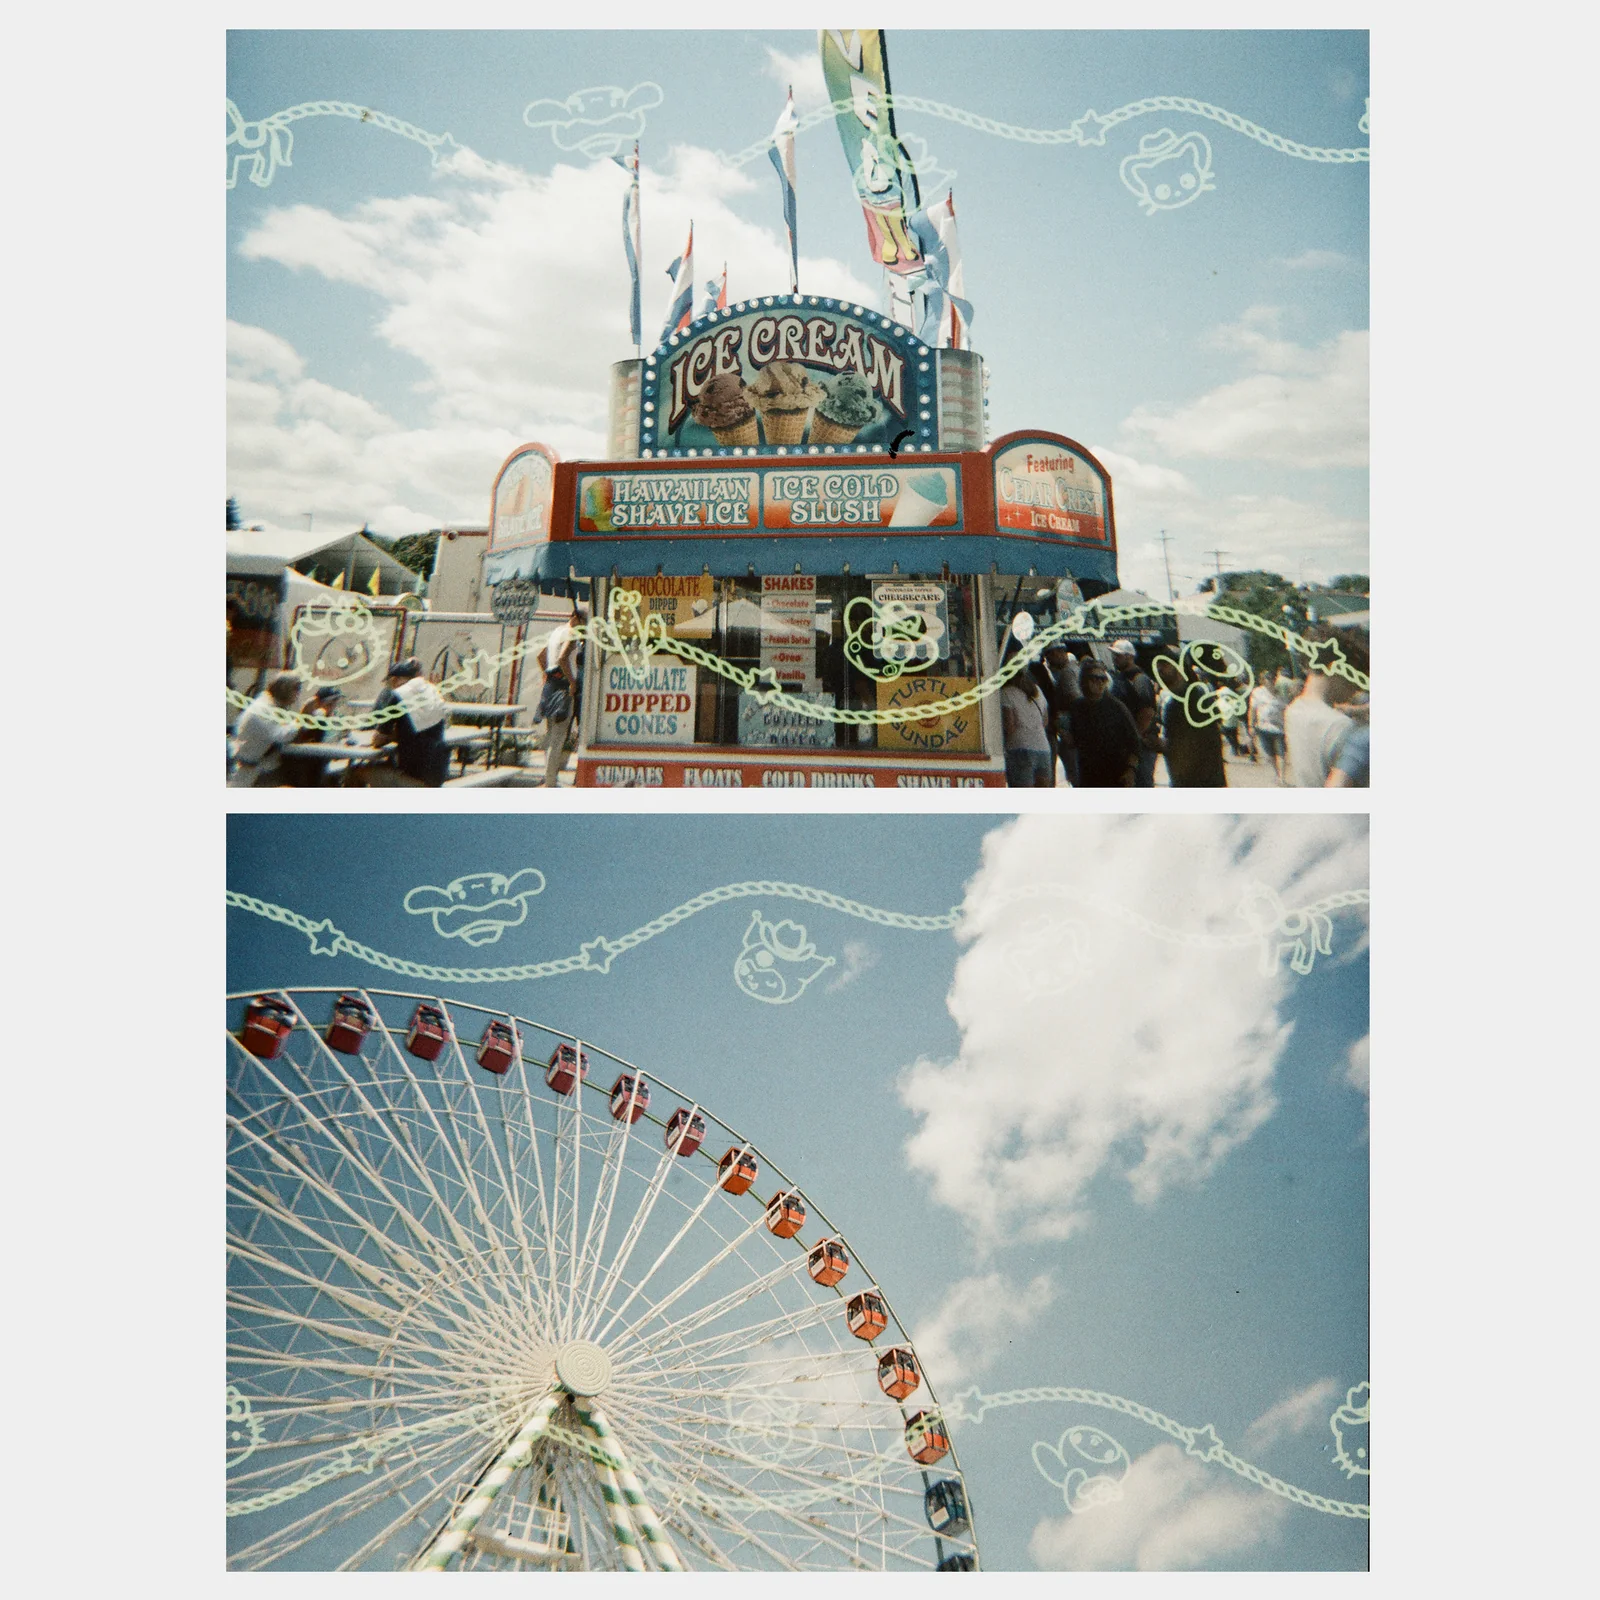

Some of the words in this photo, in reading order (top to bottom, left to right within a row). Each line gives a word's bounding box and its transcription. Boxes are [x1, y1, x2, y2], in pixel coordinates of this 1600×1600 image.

[669, 326, 742, 430] ICE
[749, 315, 905, 420] CREAM
[1026, 453, 1075, 473] Featuring
[612, 477, 751, 502] HAWAIIAN
[772, 475, 820, 500] ICE
[823, 473, 899, 499] COLD
[999, 466, 1055, 508] CEDAR
[1055, 476, 1101, 516] CREST
[610, 502, 702, 526] SHAVE
[704, 501, 750, 525] ICE
[790, 499, 882, 524] SLUSH
[1030, 510, 1047, 528] ICE
[1048, 514, 1080, 532] CREAM
[631, 575, 702, 597] CHOCOLATE
[764, 577, 814, 591] SHAKES
[649, 597, 678, 611] DIPPED
[878, 594, 941, 602] CHEESECAKE
[775, 669, 806, 680] Vanilla
[604, 692, 692, 713] DIPPED
[615, 714, 678, 735] CONES
[595, 764, 663, 786] SUNDAES
[683, 767, 742, 787] FLOATS
[762, 769, 806, 788] COLD
[811, 771, 875, 788] DRINKS
[896, 774, 951, 788] SHAVE
[956, 776, 984, 788] ICE
